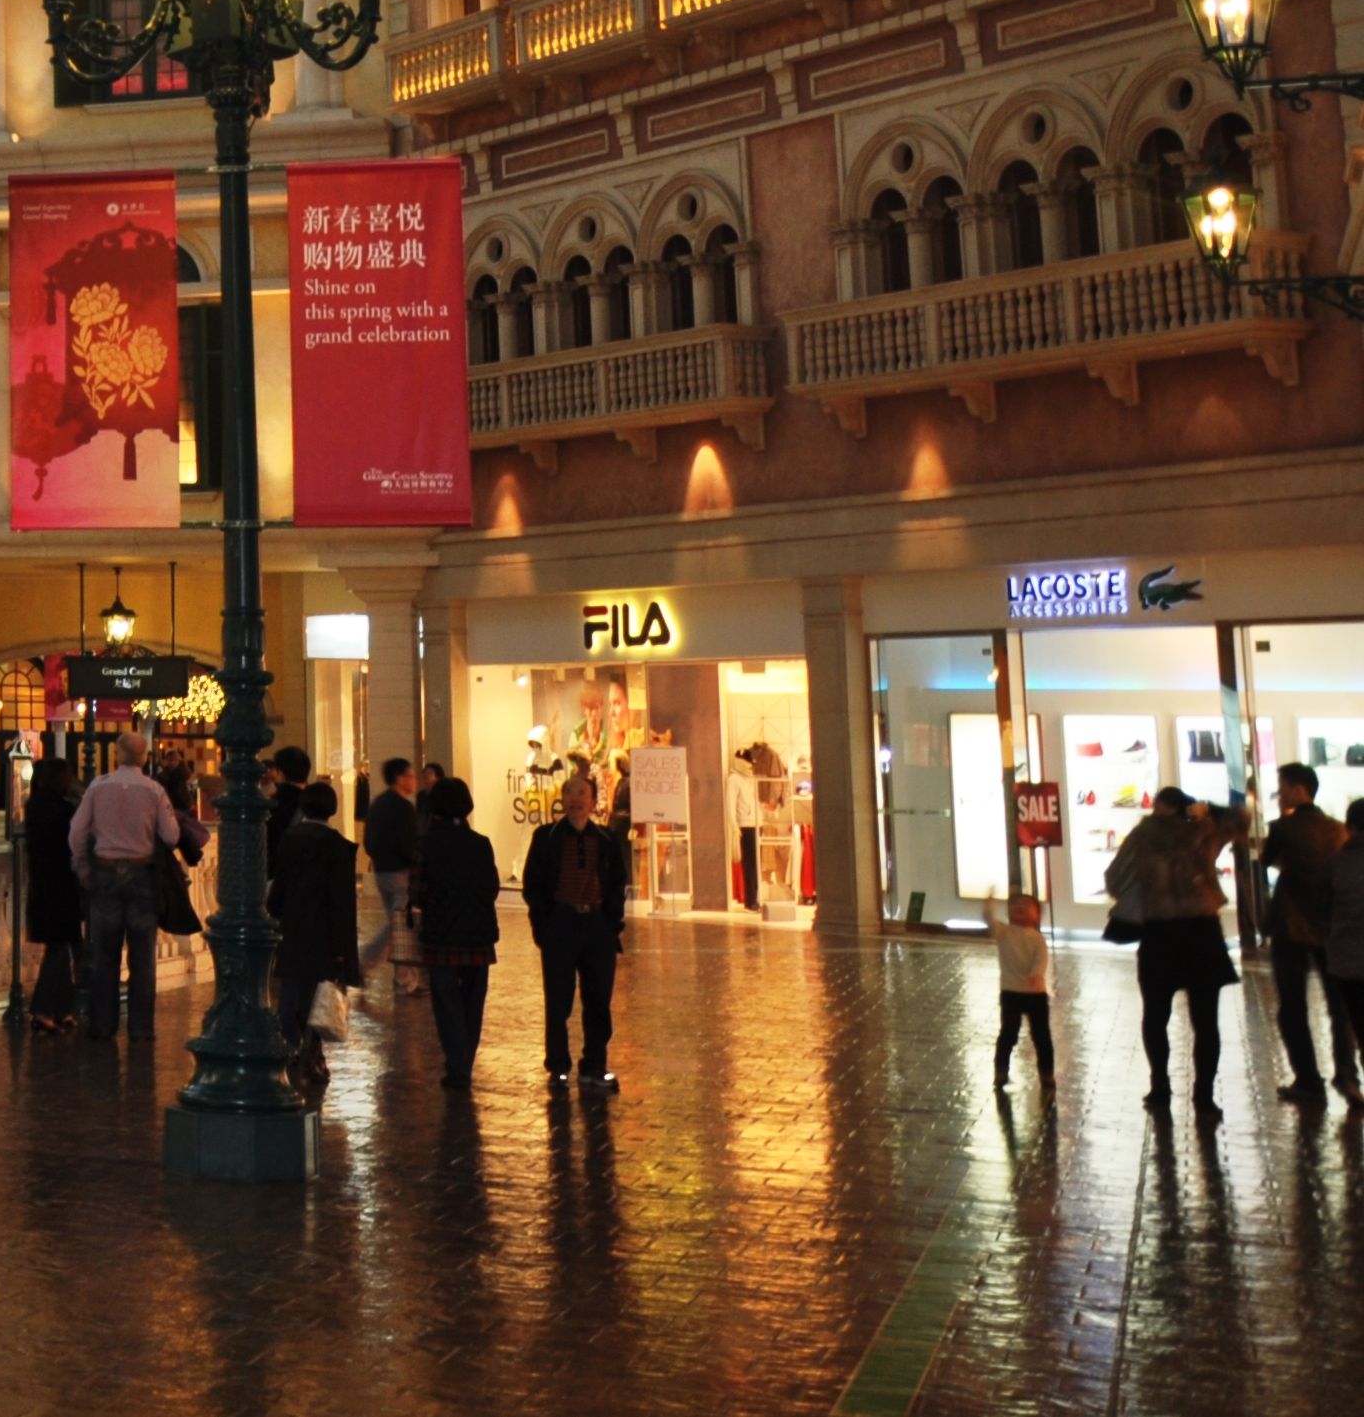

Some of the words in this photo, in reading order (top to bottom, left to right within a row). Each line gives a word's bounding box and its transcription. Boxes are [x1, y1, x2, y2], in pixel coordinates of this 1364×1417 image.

[303, 202, 425, 234] 新春喜悦
[303, 238, 426, 271] 购物盛典
[304, 278, 350, 296] Shine
[354, 282, 376, 294] on
[305, 302, 335, 320] this
[340, 303, 392, 324] spring
[396, 299, 433, 317] with
[439, 305, 449, 317] a
[305, 325, 352, 350] grand
[358, 325, 450, 343] celebration
[1007, 571, 1123, 602] LACOSTE
[1009, 600, 1128, 618] ACCESSORIES
[582, 601, 671, 650] FILA
[101, 666, 128, 676] Grand
[129, 666, 153, 676] Canal
[636, 756, 681, 770] SALES
[636, 782, 682, 796] INSIDE
[513, 789, 567, 824] sale
[1017, 795, 1059, 822] SALE
